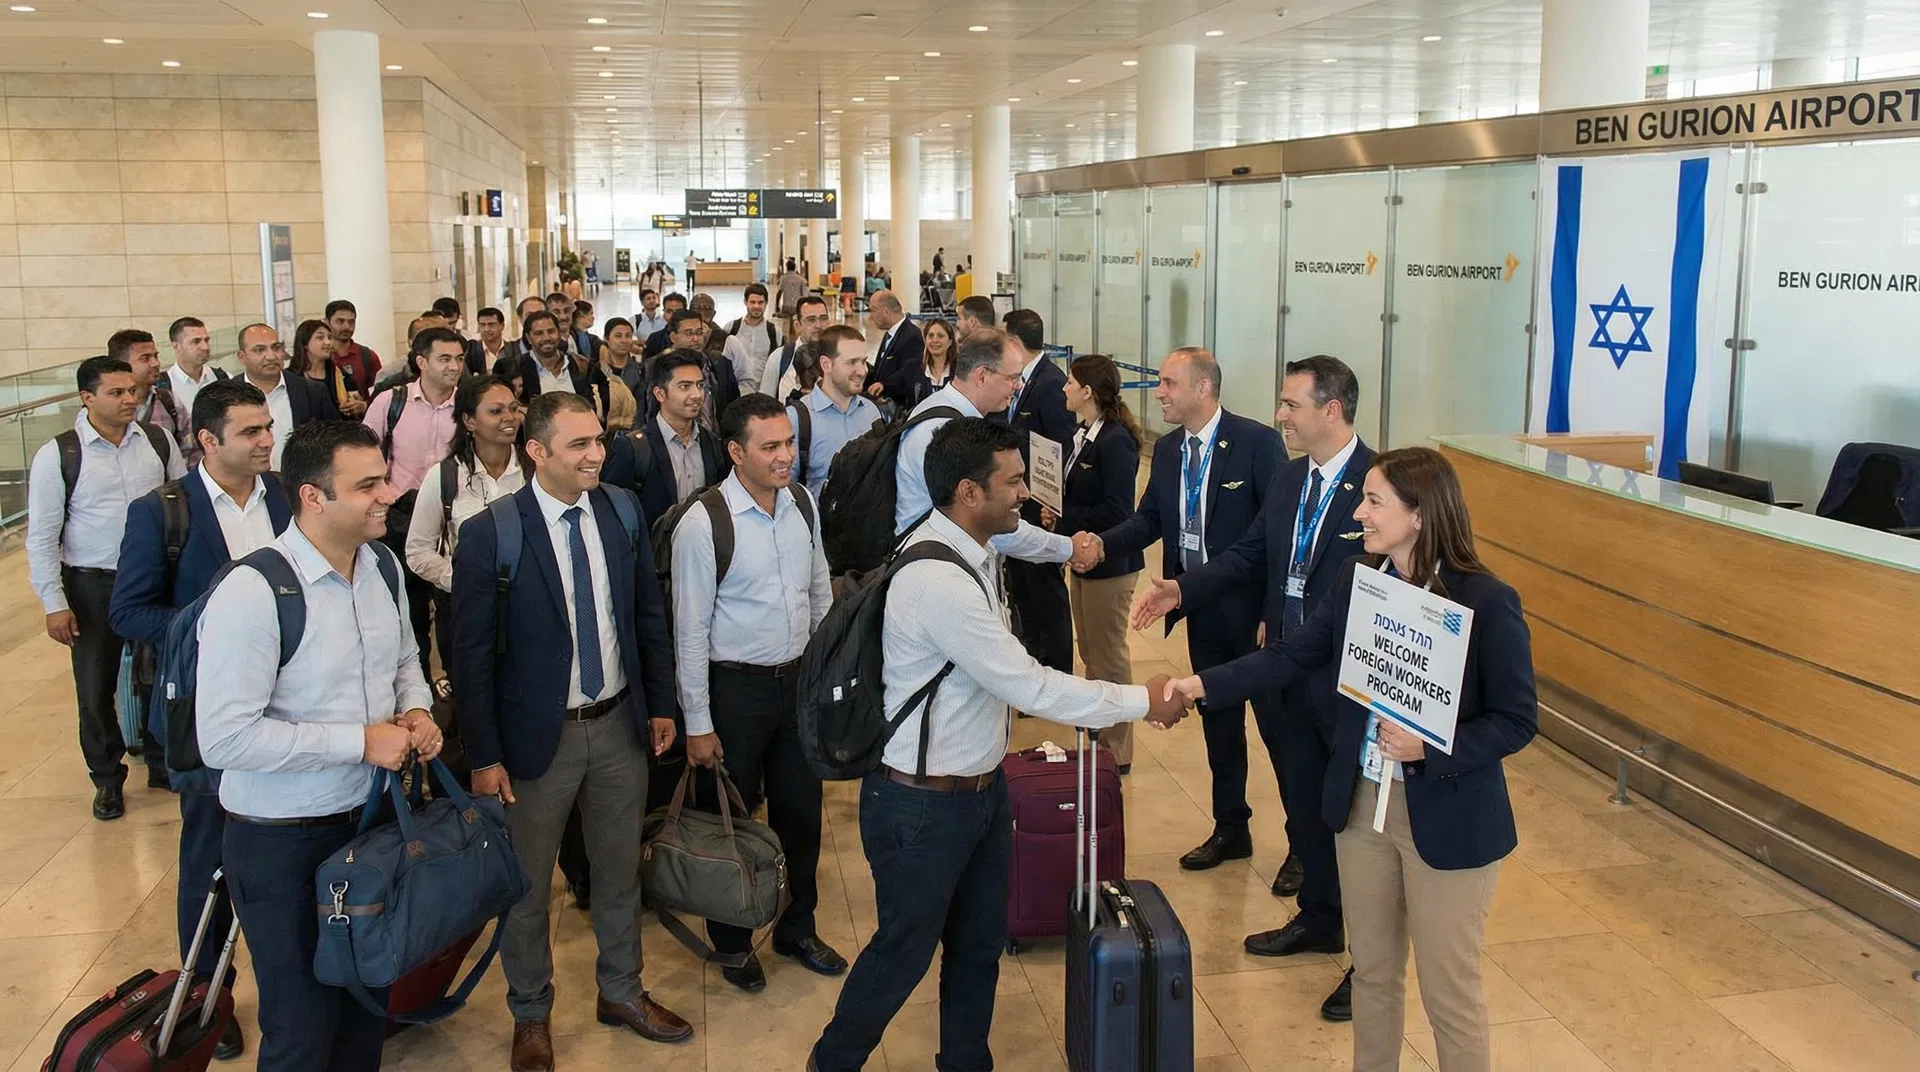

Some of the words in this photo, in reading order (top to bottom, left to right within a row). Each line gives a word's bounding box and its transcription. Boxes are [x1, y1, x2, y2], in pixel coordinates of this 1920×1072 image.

[1575, 114, 1629, 145] BEN
[1637, 102, 1756, 141] GURION
[1764, 88, 1920, 132] AIRPORT
[1406, 263, 1424, 277] BEN
[1425, 264, 1459, 278] GURION
[1460, 265, 1502, 280] AIRPORT
[1778, 271, 1810, 288] BEN
[1816, 272, 1881, 290] GURION
[1885, 274, 1920, 292] AIR
[1374, 632, 1429, 672] WELCOME
[1348, 642, 1393, 677] FOREIGN
[1395, 664, 1452, 706] WORKERS
[1366, 673, 1423, 715] PROGRAM
